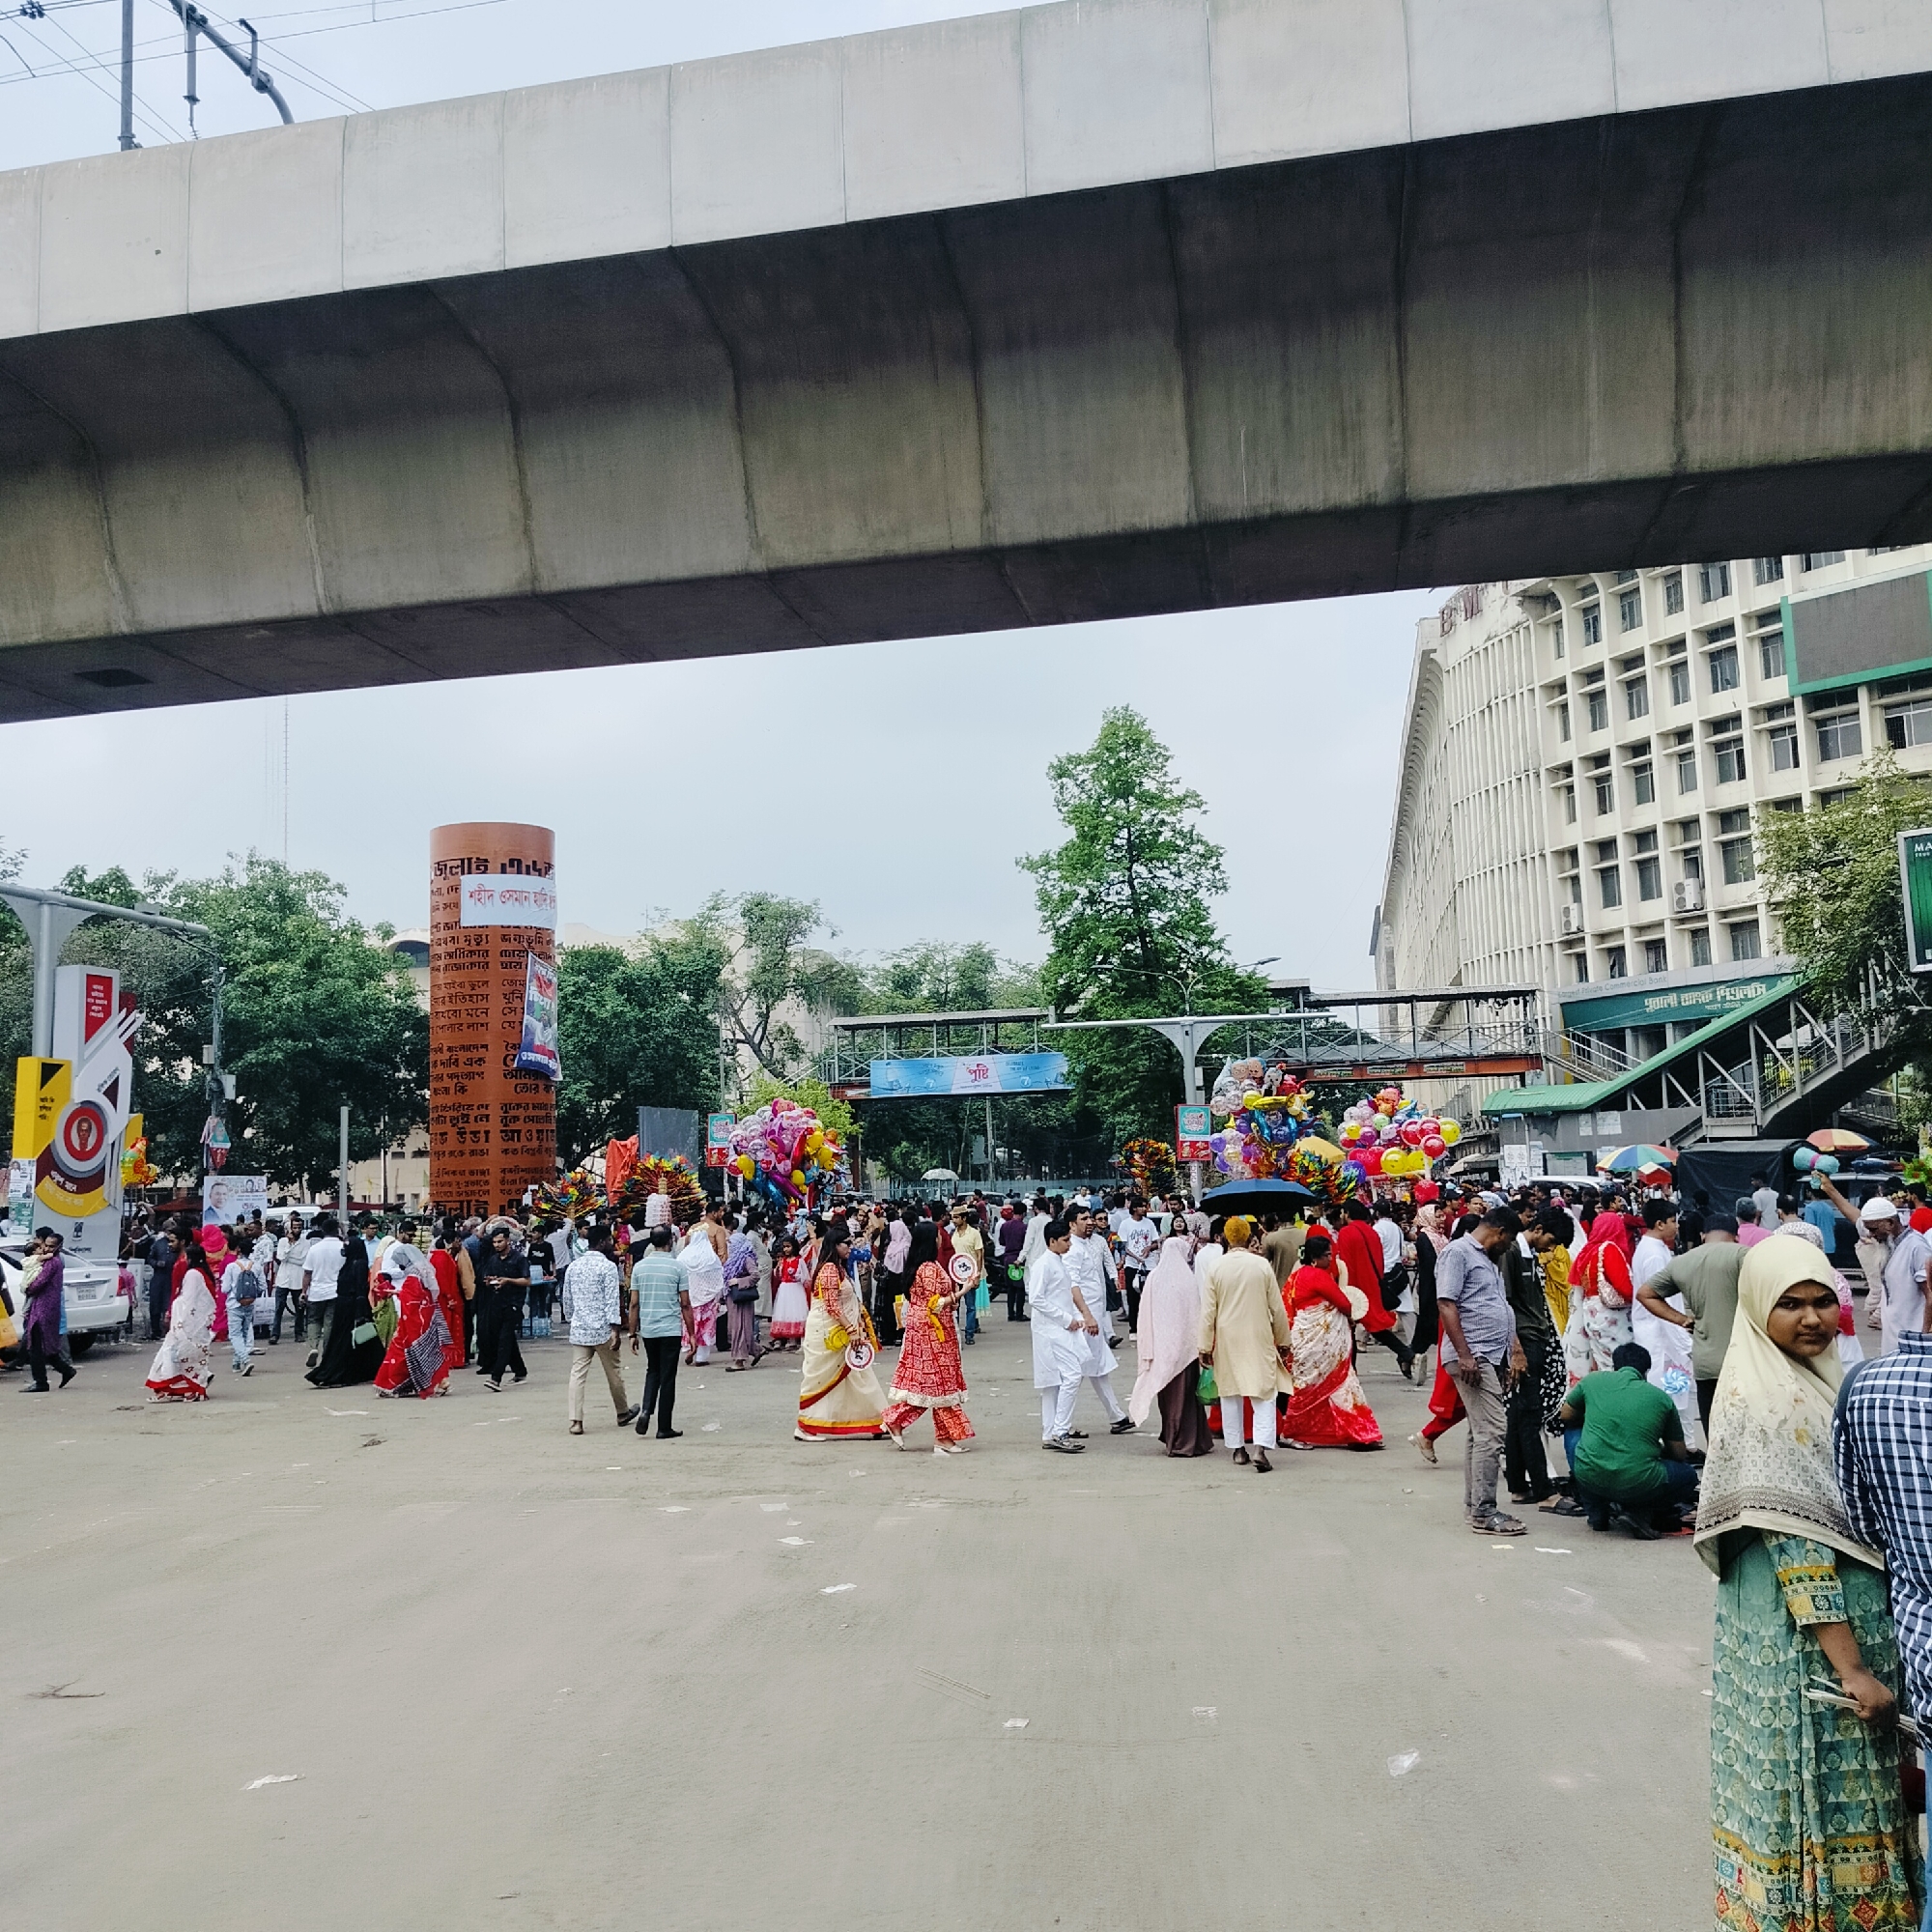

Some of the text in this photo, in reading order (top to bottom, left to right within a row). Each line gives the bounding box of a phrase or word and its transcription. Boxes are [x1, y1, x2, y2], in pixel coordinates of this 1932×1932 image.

[468, 883, 496, 907] শহীদ
[499, 889, 530, 908] ওসমান
[443, 948, 490, 960] অধিকার
[443, 961, 490, 974] রাজাকার
[1581, 985, 1603, 994] Private
[1605, 978, 1647, 990] Commercial
[1649, 975, 1667, 984] Bank
[447, 991, 490, 1005] ইতিহাস
[502, 989, 523, 1005] খুনি
[1717, 982, 1767, 1002] পিএলসি
[465, 1008, 490, 1017] মনে
[467, 1022, 490, 1031] লাশ
[446, 1043, 489, 1053] বাংলাদেশ
[440, 1054, 459, 1068] দাবি
[464, 1057, 486, 1066] এক
[446, 1071, 484, 1081] পদত্যাগ
[968, 1064, 989, 1083] পুষ্টি
[454, 1082, 469, 1095] কি
[514, 1083, 539, 1094] তোর
[499, 1116, 521, 1127] বুক
